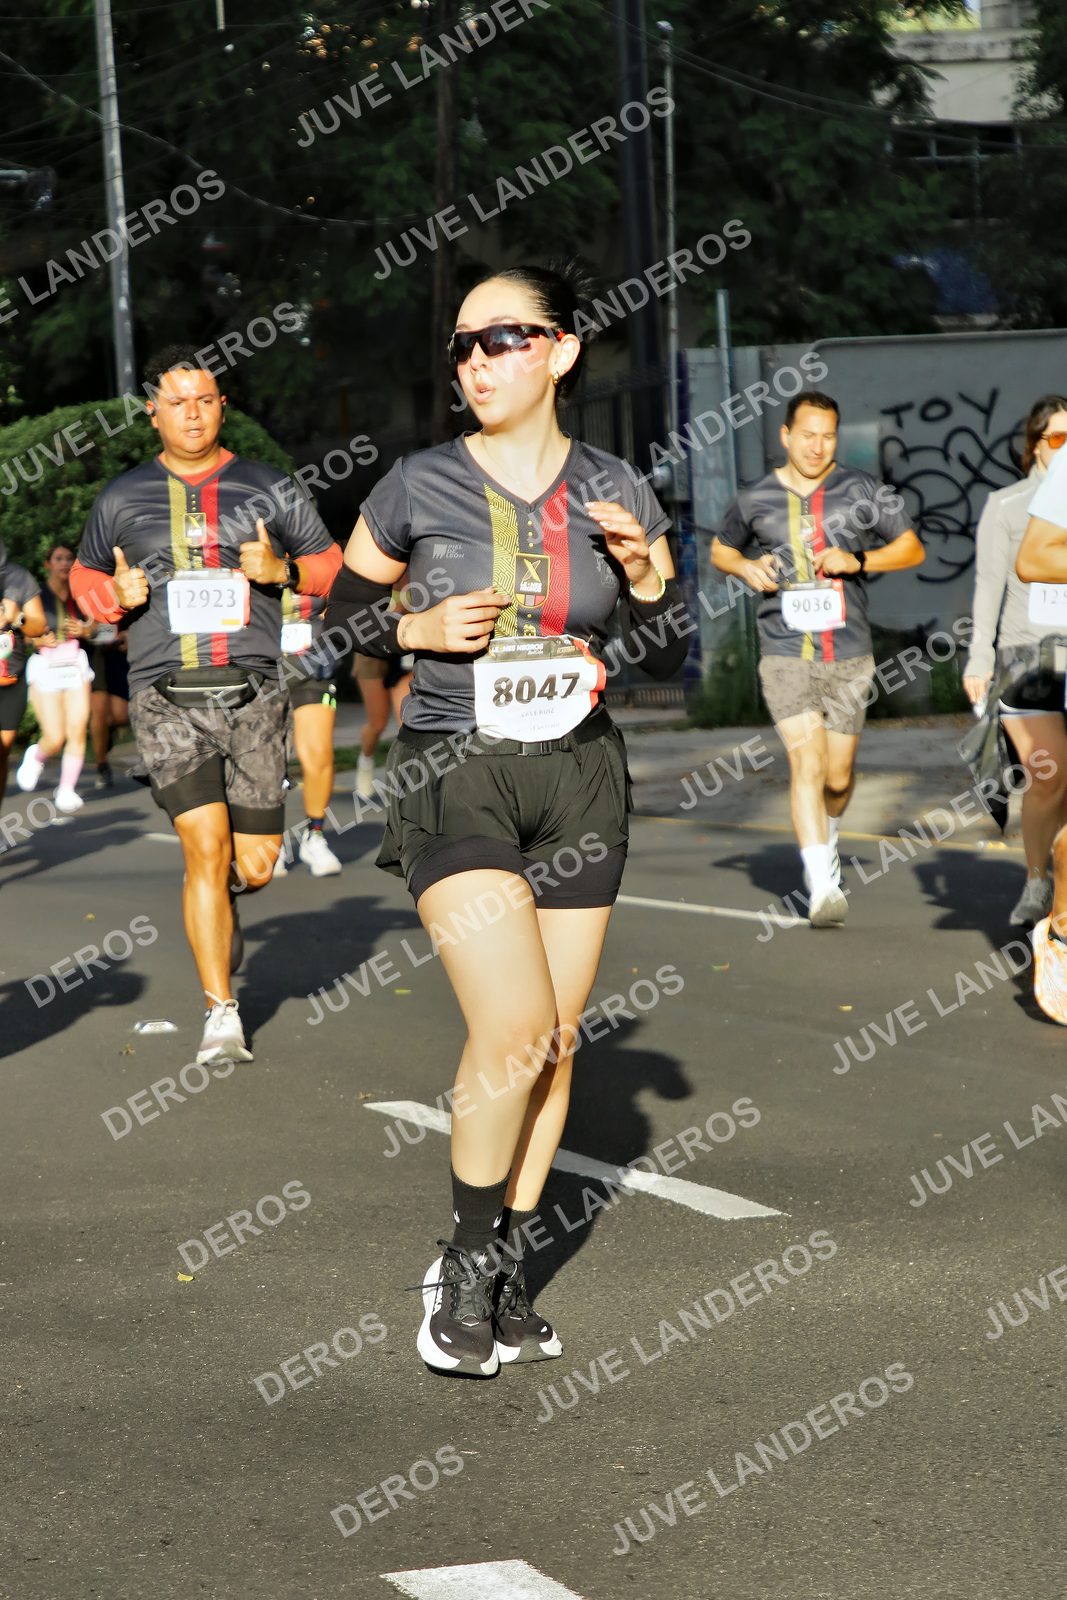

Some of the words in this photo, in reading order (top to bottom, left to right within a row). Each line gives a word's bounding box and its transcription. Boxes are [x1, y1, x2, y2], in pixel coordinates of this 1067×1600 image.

[881, 386, 999, 435] TOY
[173, 588, 236, 609] 12923
[792, 596, 832, 613] 9036
[492, 672, 580, 708] 8047
